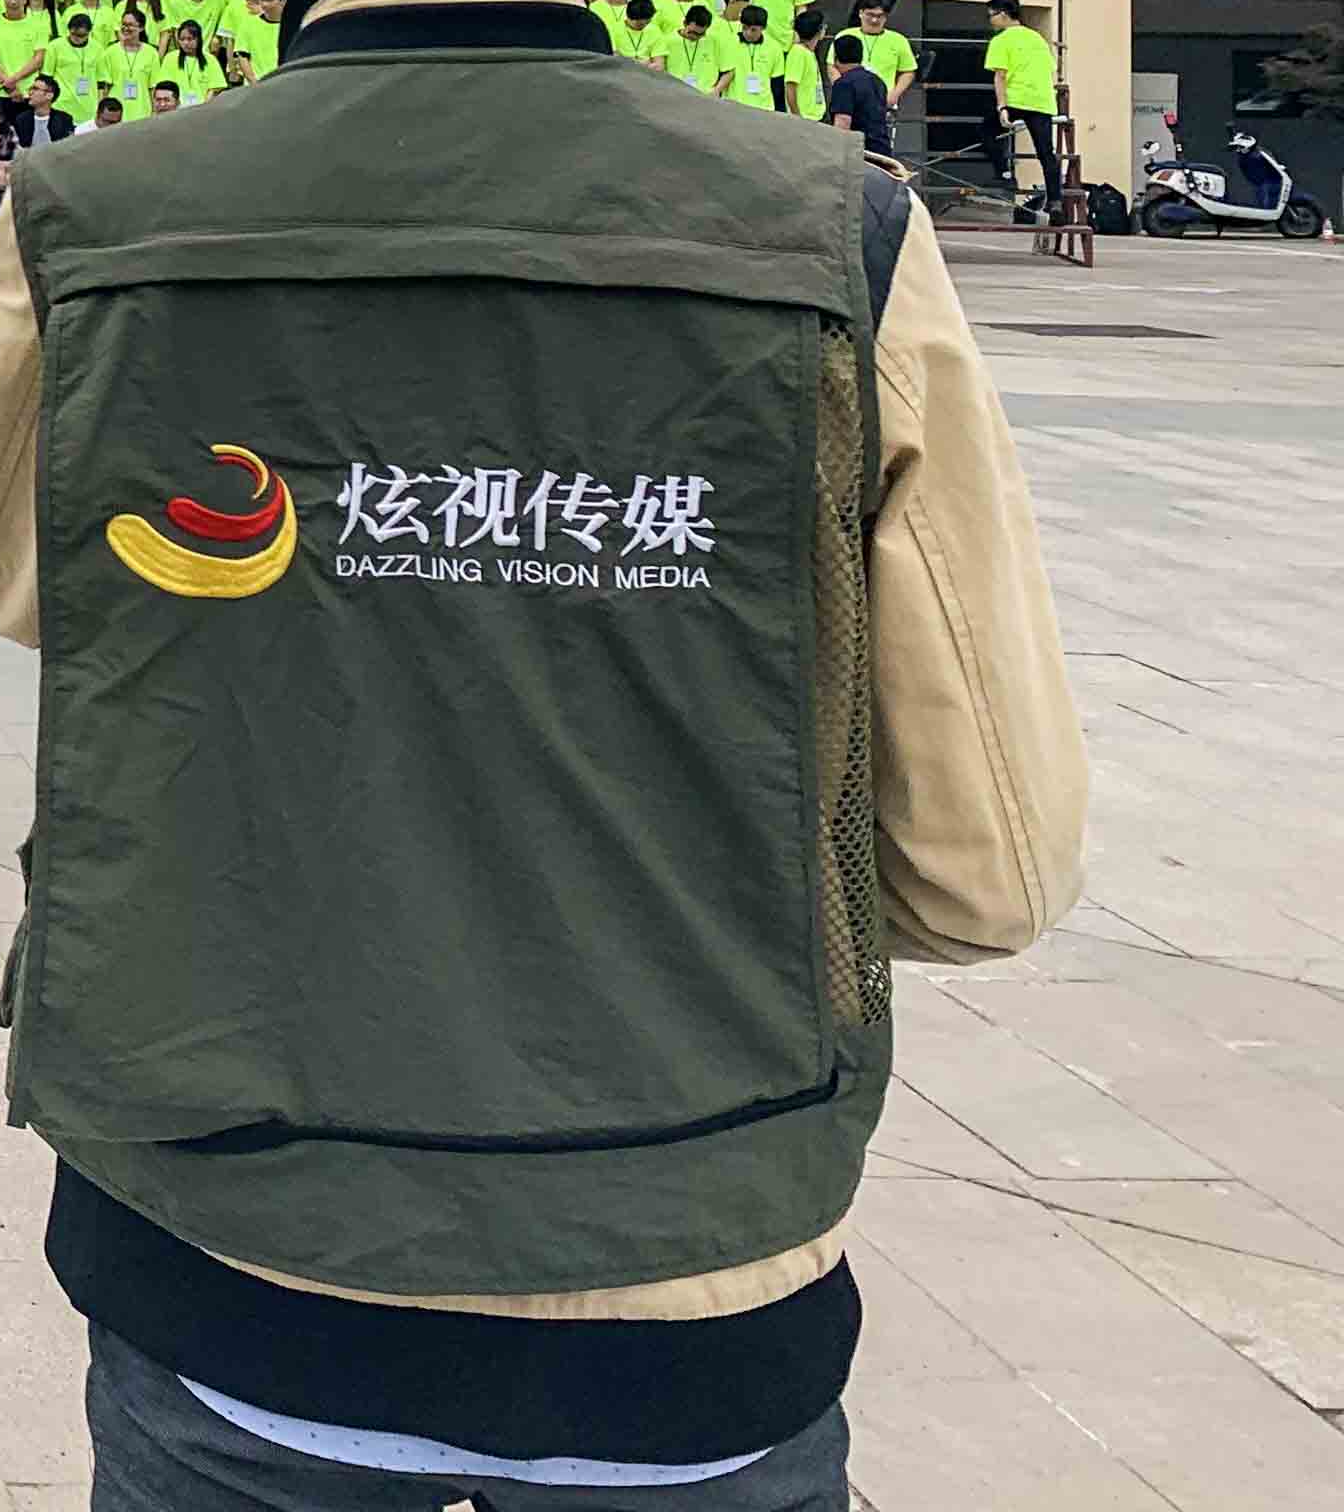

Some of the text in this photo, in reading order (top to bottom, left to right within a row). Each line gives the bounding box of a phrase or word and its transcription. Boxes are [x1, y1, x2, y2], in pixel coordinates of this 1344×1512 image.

[336, 462, 716, 557] 炫视传媒
[336, 554, 712, 590] DAZZLING VISION MEDIA
